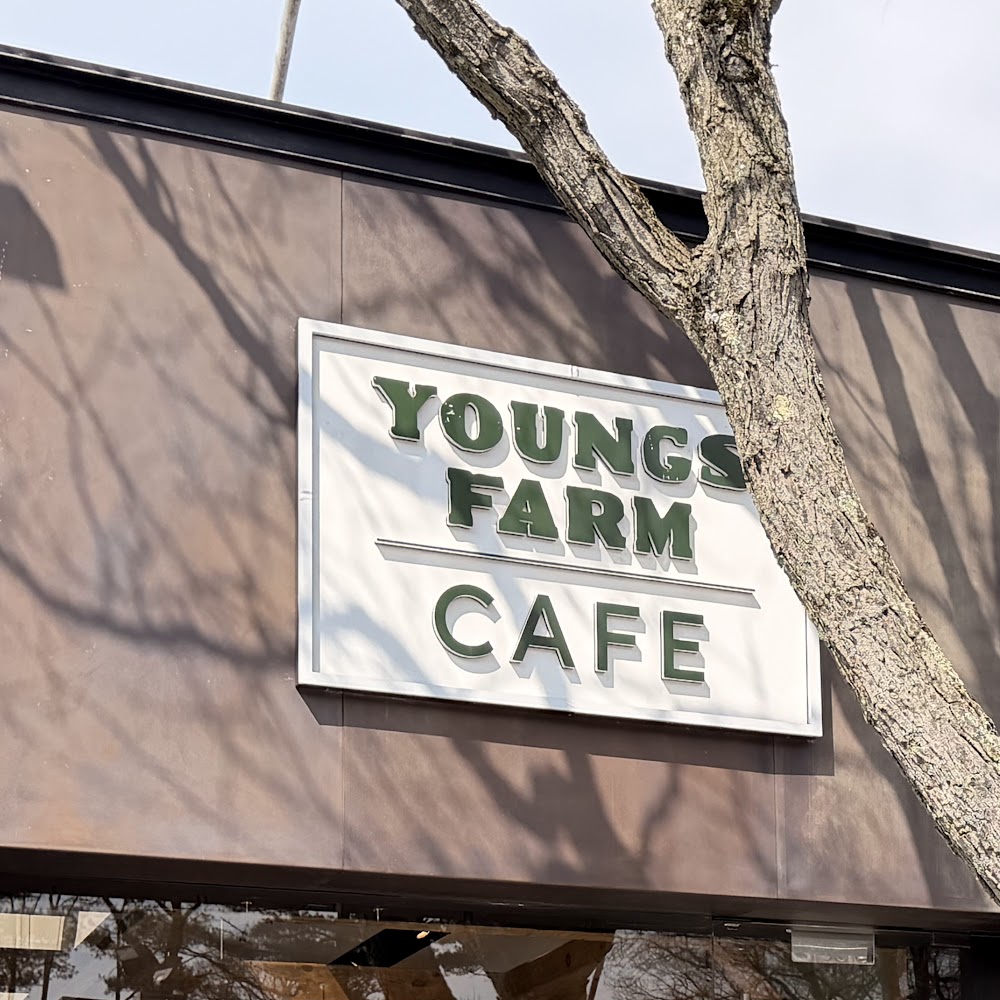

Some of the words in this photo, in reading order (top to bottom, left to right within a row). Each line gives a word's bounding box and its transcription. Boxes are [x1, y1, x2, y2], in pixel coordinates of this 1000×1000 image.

[372, 375, 748, 492] YOUNGS
[445, 466, 694, 561] FARM
[432, 583, 706, 684] CAFE
